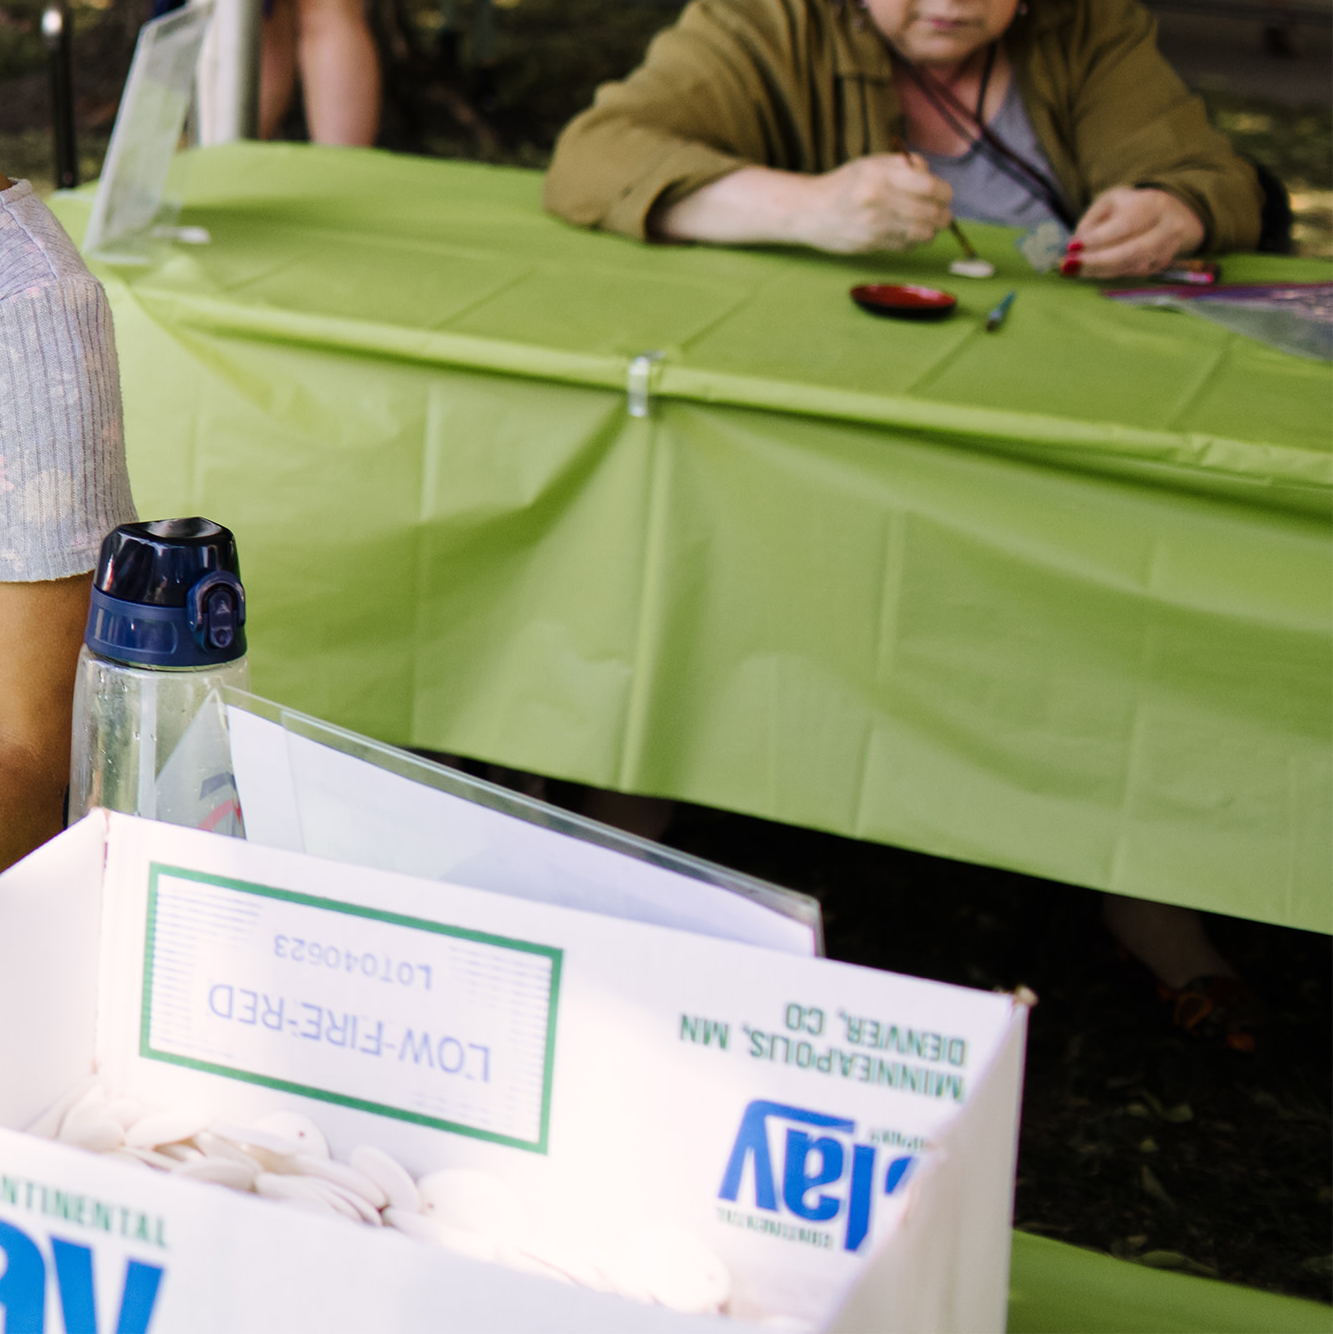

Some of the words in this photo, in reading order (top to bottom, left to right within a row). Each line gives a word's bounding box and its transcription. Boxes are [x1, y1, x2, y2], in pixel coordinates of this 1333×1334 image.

[273, 934, 433, 991] LOT040623
[208, 983, 491, 1083] LOW-FIRE-RED
[680, 1014, 729, 1050] MN
[785, 1003, 824, 1035] CO
[839, 1010, 966, 1066] DENVER,
[742, 1024, 964, 1100] MINNEAPOLIS,
[717, 1099, 915, 1253] lay
